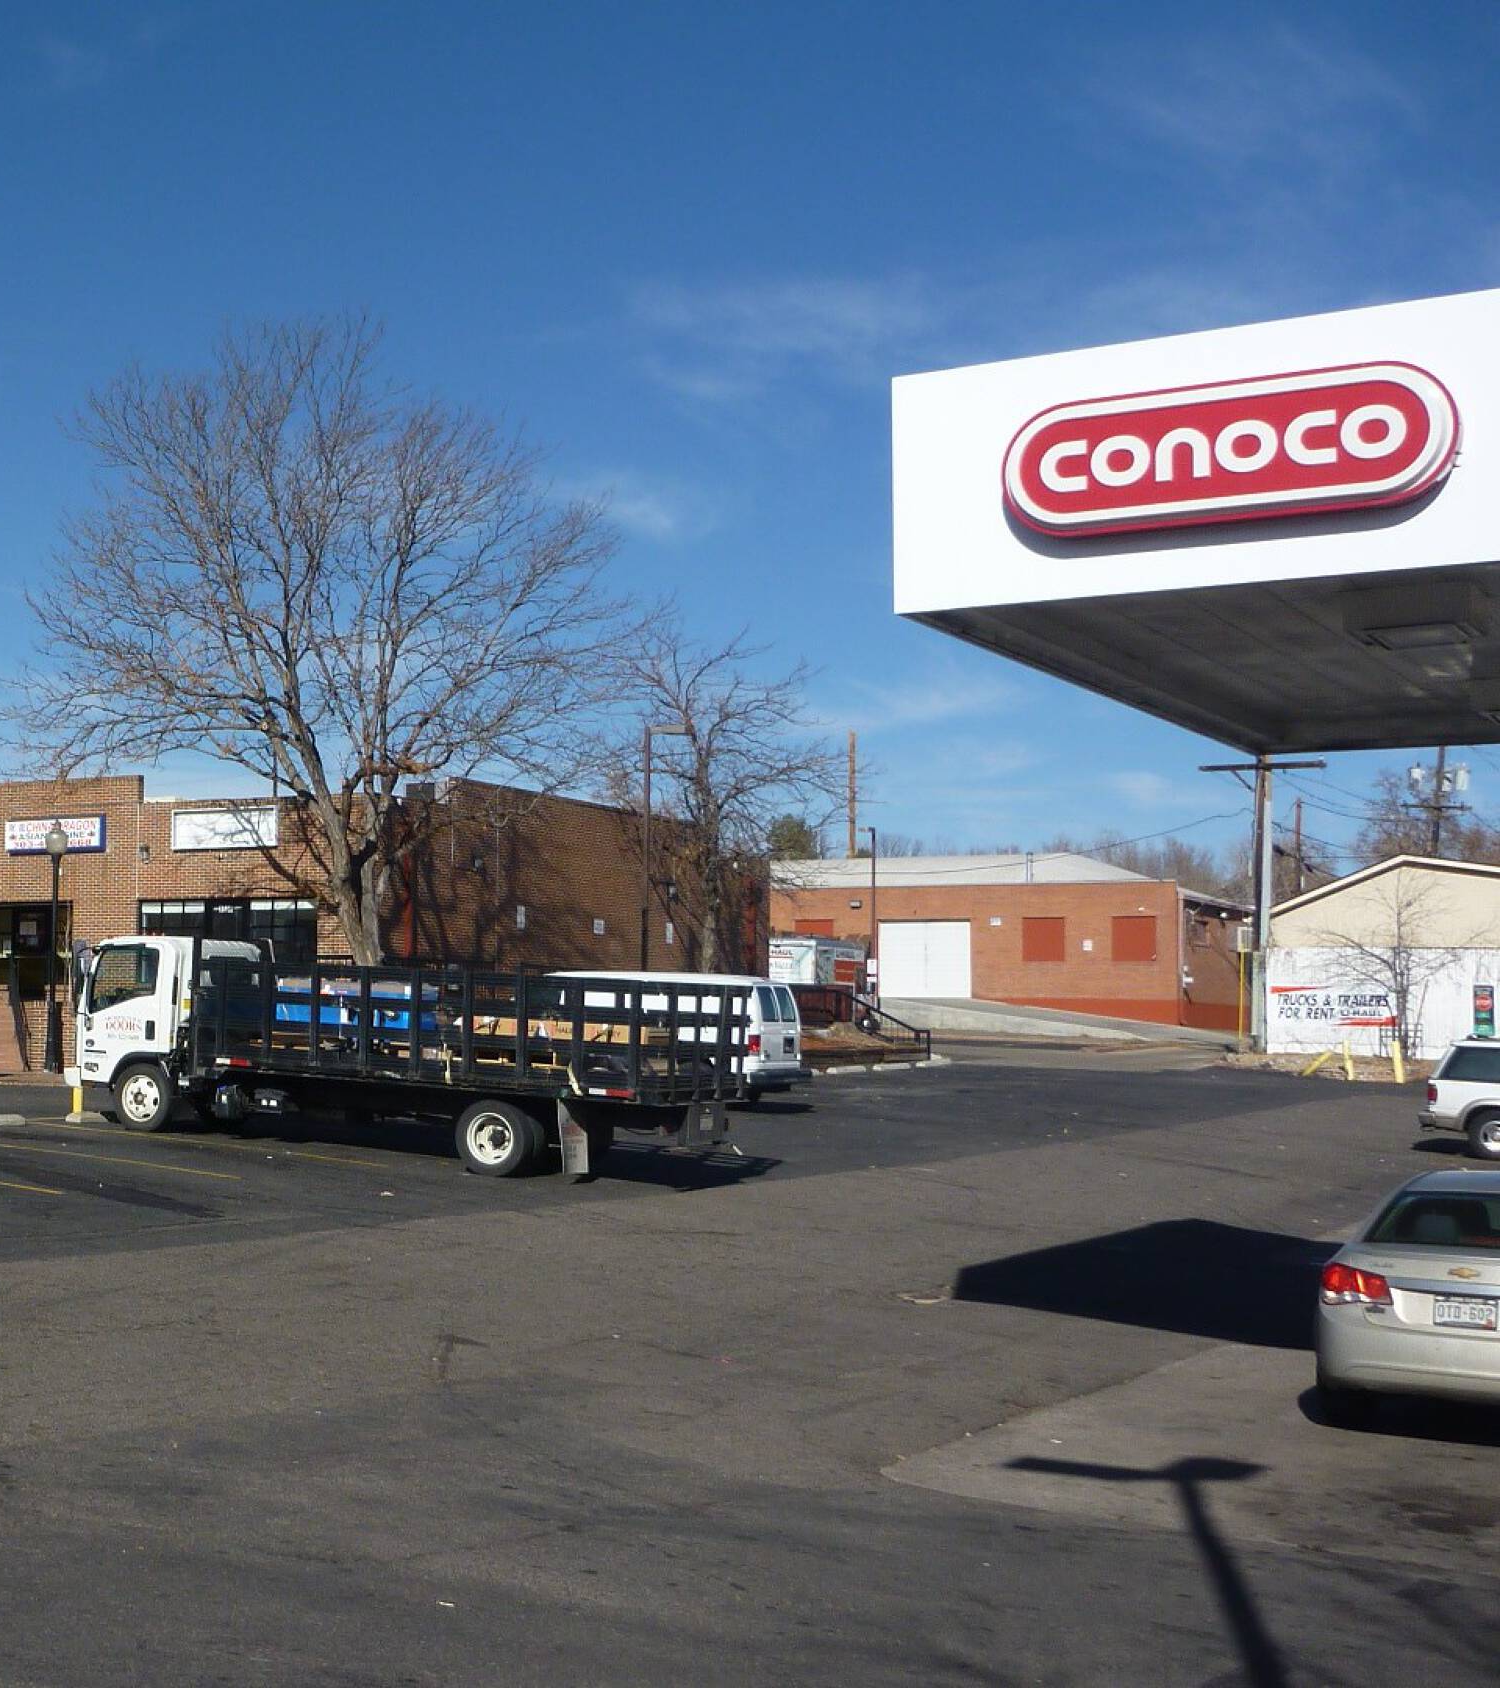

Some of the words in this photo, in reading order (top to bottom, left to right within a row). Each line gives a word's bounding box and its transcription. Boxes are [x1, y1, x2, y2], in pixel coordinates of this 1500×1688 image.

[1278, 994, 1318, 1005] TRUCKS
[1323, 994, 1332, 1006] &
[1338, 994, 1389, 1007] TRAILERS
[1279, 1007, 1300, 1019] FOR
[1306, 1007, 1334, 1019] RENT
